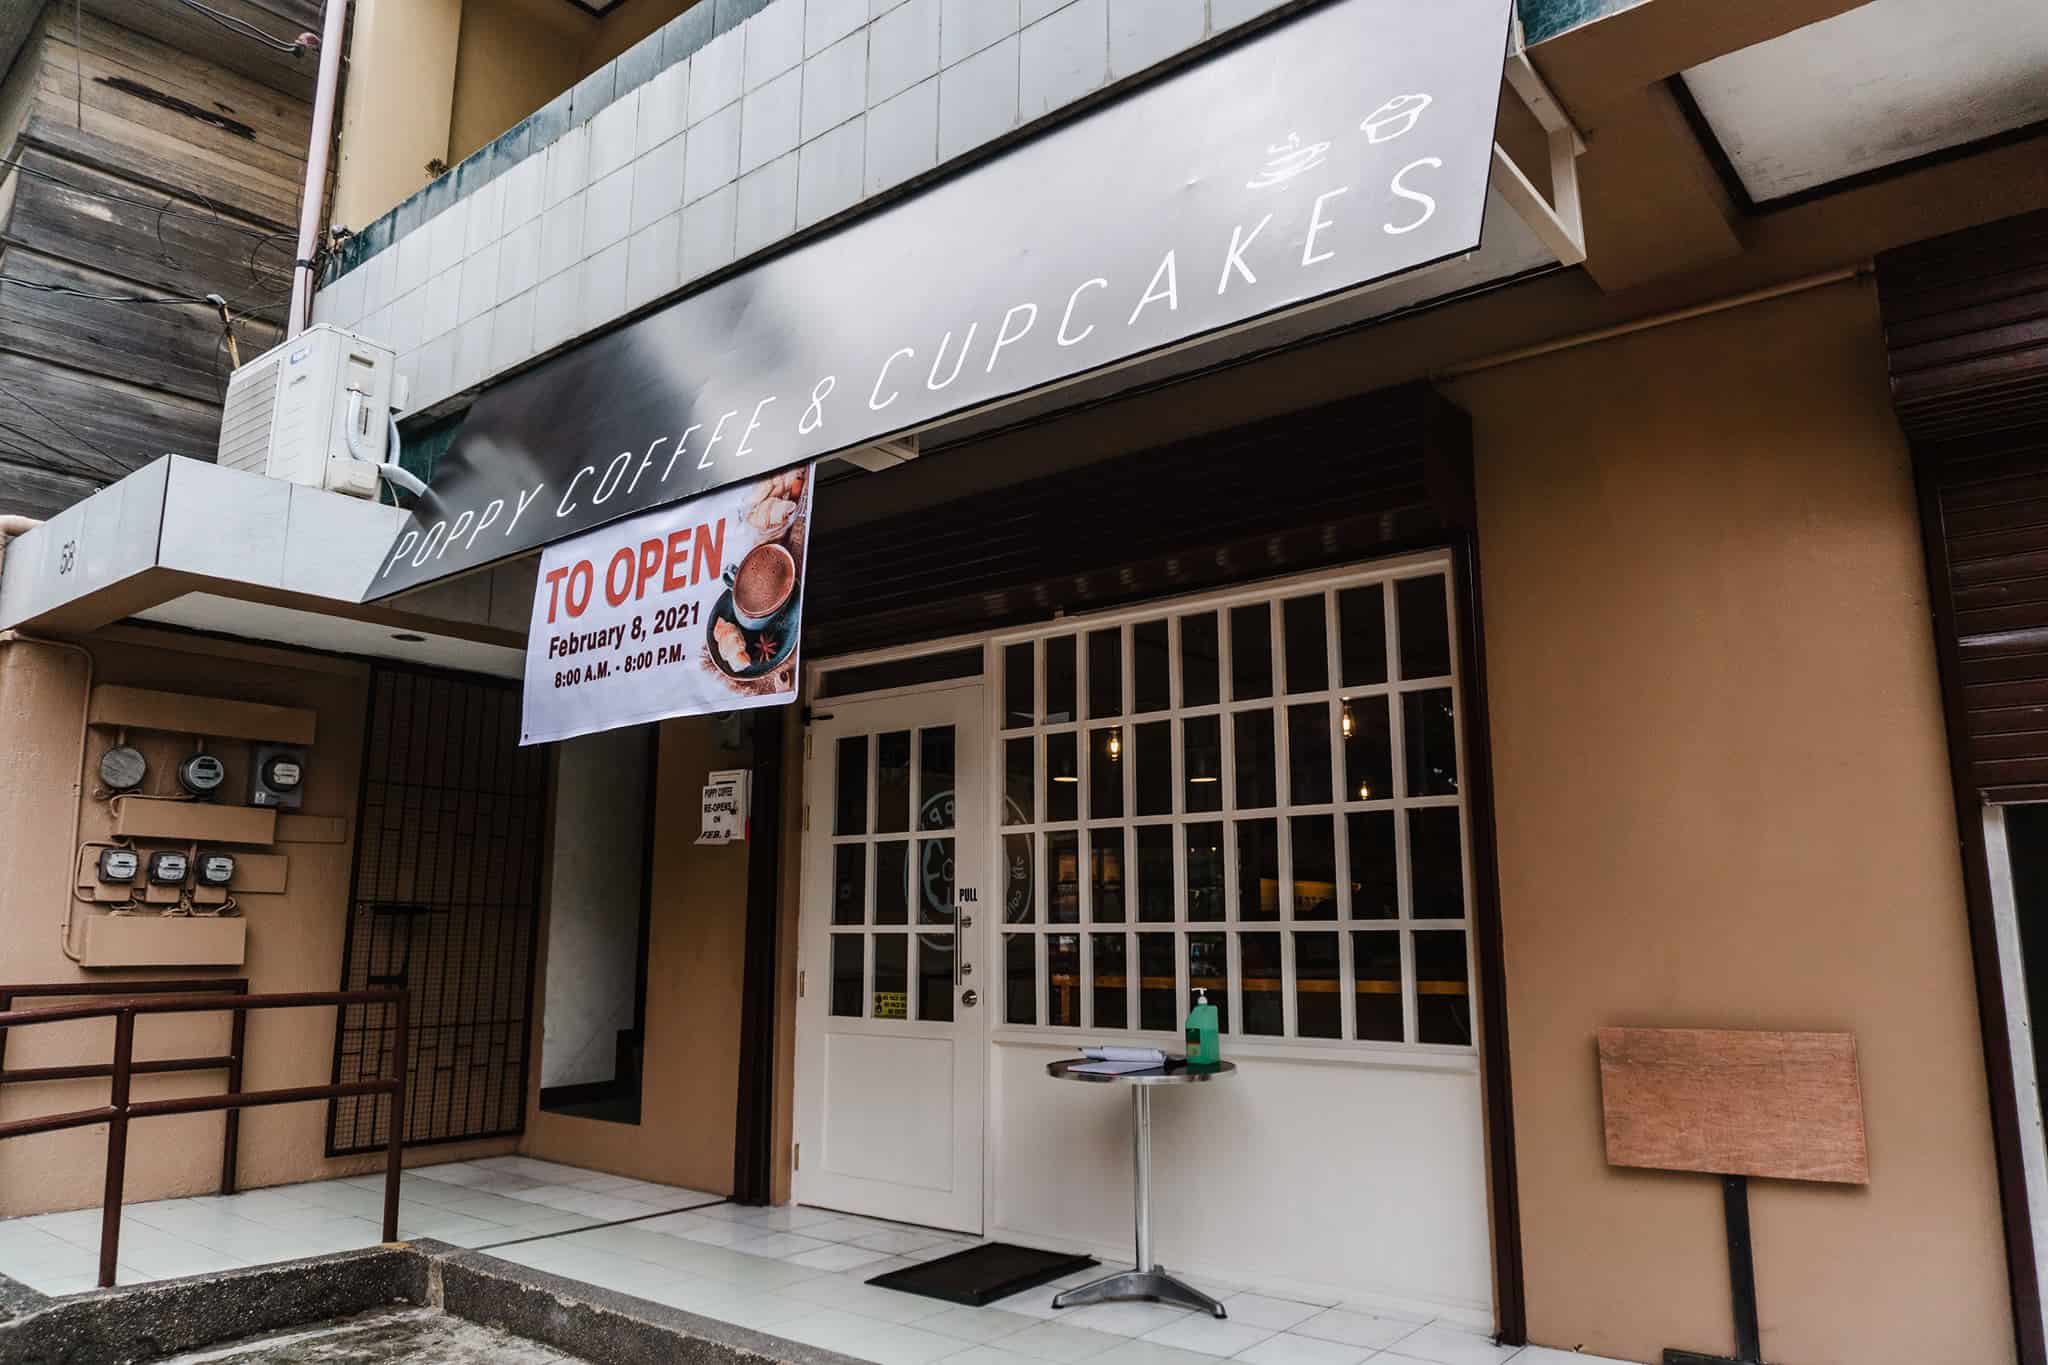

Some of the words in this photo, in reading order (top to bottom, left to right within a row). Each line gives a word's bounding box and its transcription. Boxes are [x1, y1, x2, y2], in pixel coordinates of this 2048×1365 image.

[383, 483, 544, 578] POPPY
[556, 396, 777, 518] COFFEE
[799, 375, 836, 434] &
[868, 156, 1442, 411] CUPCAKES
[60, 539, 76, 575] 58
[545, 559, 594, 625] TO
[605, 517, 727, 607] OPEN
[549, 623, 626, 659] February
[631, 615, 647, 642] 8,
[653, 601, 700, 635] 2021
[554, 665, 581, 689] 8:00
[584, 658, 612, 683] A.M.
[624, 652, 652, 673] 8:00
[657, 643, 686, 667] P.M.
[959, 888, 978, 902] PULL
